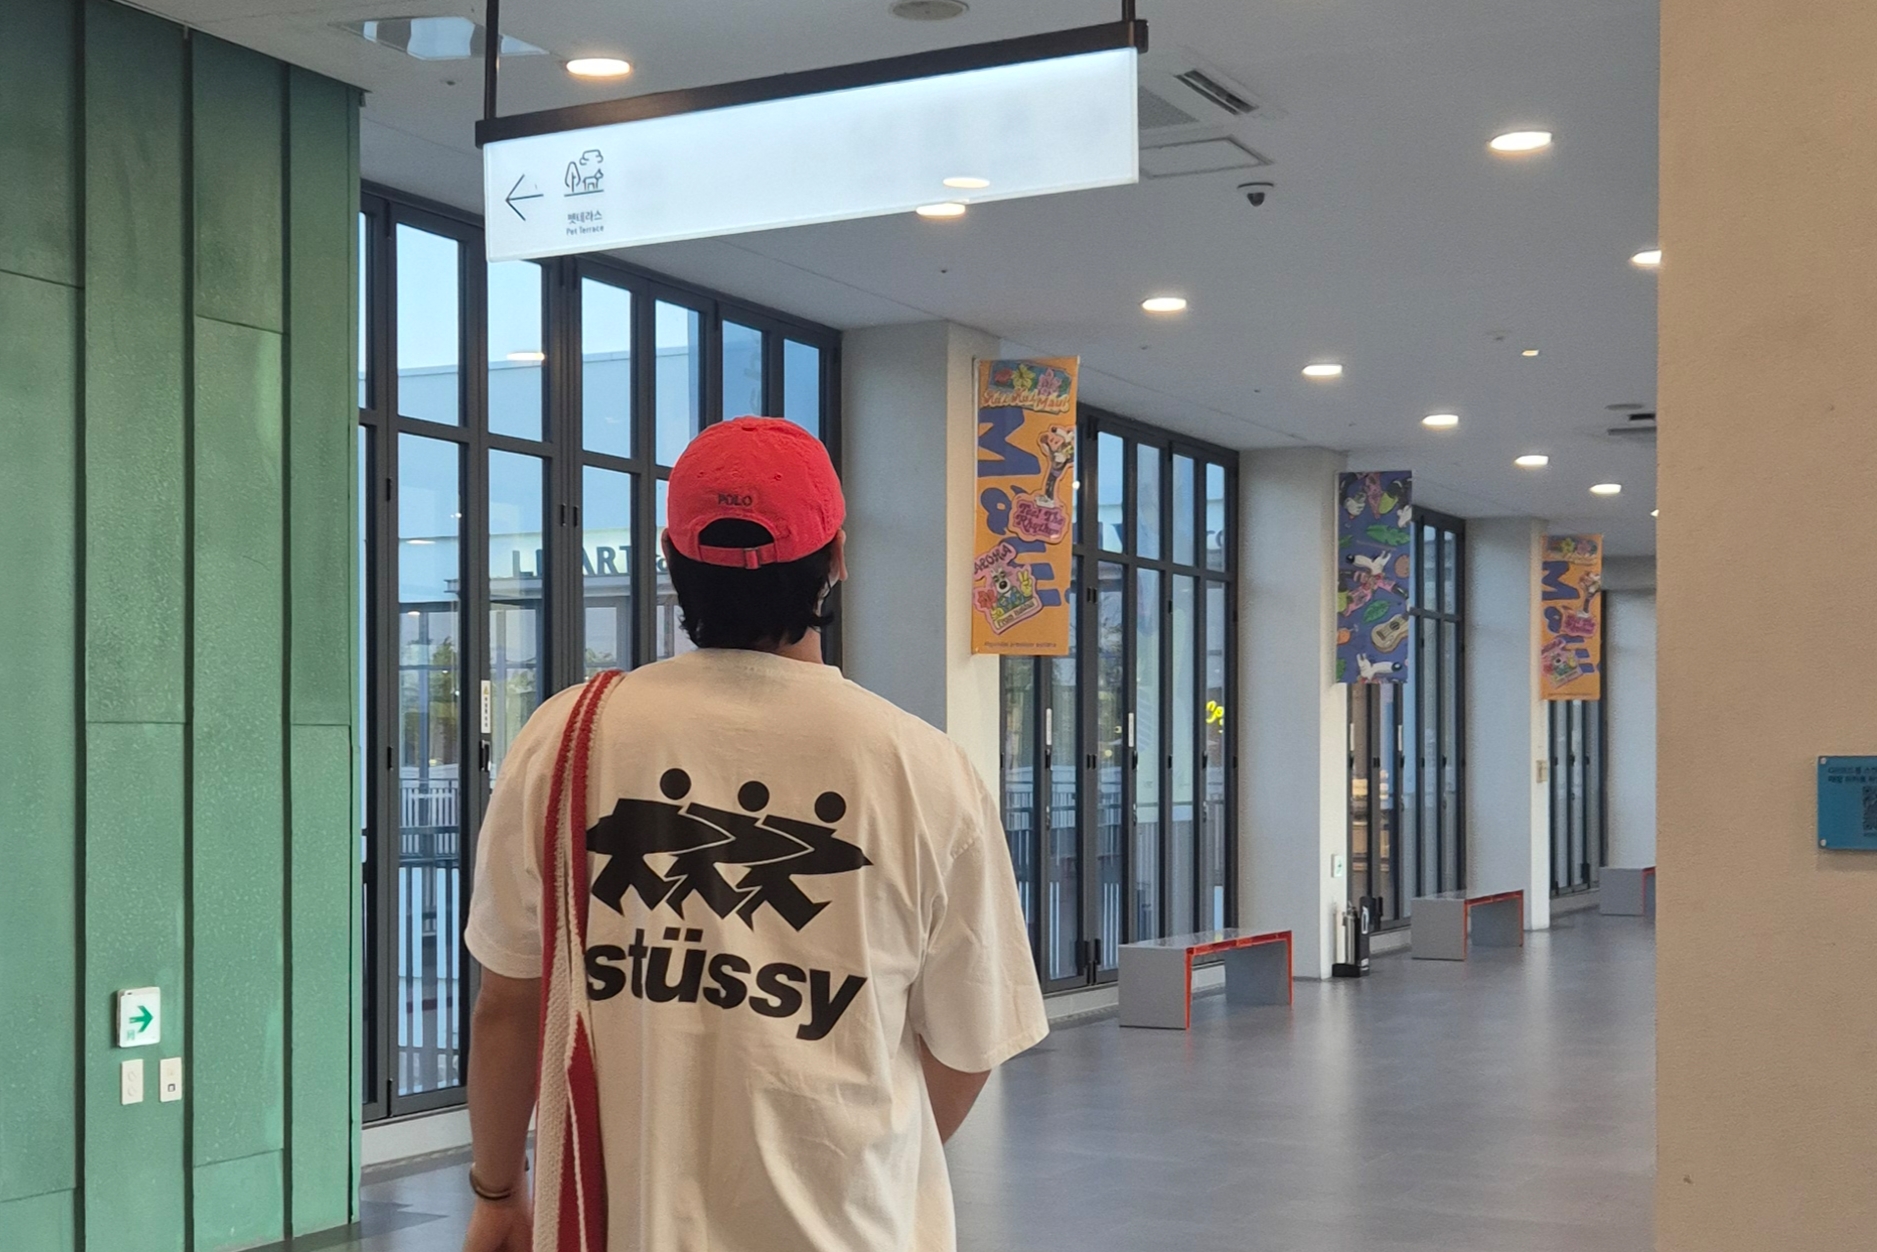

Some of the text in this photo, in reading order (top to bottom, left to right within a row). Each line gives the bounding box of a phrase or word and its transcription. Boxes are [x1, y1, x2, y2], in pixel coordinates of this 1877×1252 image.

[566, 225, 604, 236] Pet Terrace
[718, 494, 753, 507] POLO
[584, 926, 868, 1041] stüssy
